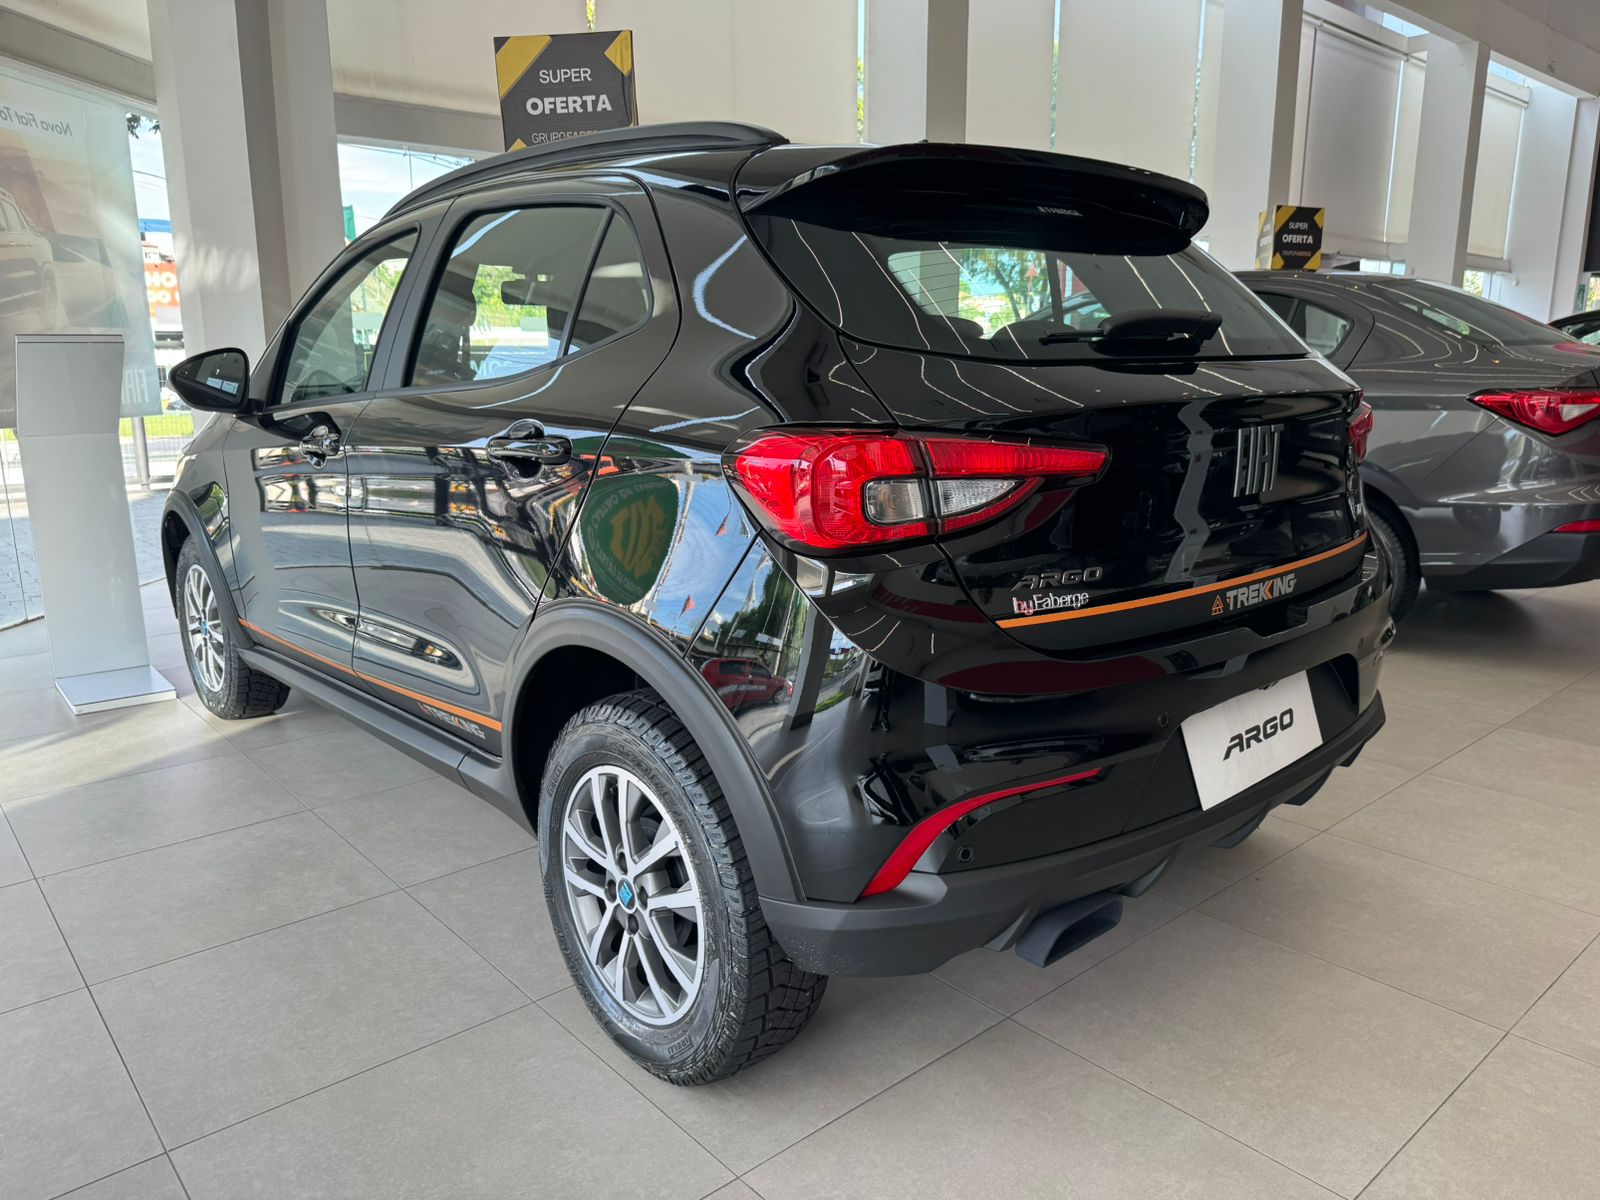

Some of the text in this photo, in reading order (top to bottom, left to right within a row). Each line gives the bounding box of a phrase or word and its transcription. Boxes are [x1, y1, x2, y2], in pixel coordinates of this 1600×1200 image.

[539, 68, 592, 84] SUPER
[525, 94, 613, 116] OFERTA
[1289, 222, 1308, 230] SUPER
[1282, 234, 1313, 244] OFERTA
[1233, 424, 1284, 498] FIAT
[1009, 566, 1103, 592] ARGO
[1223, 708, 1294, 761] ARGO
